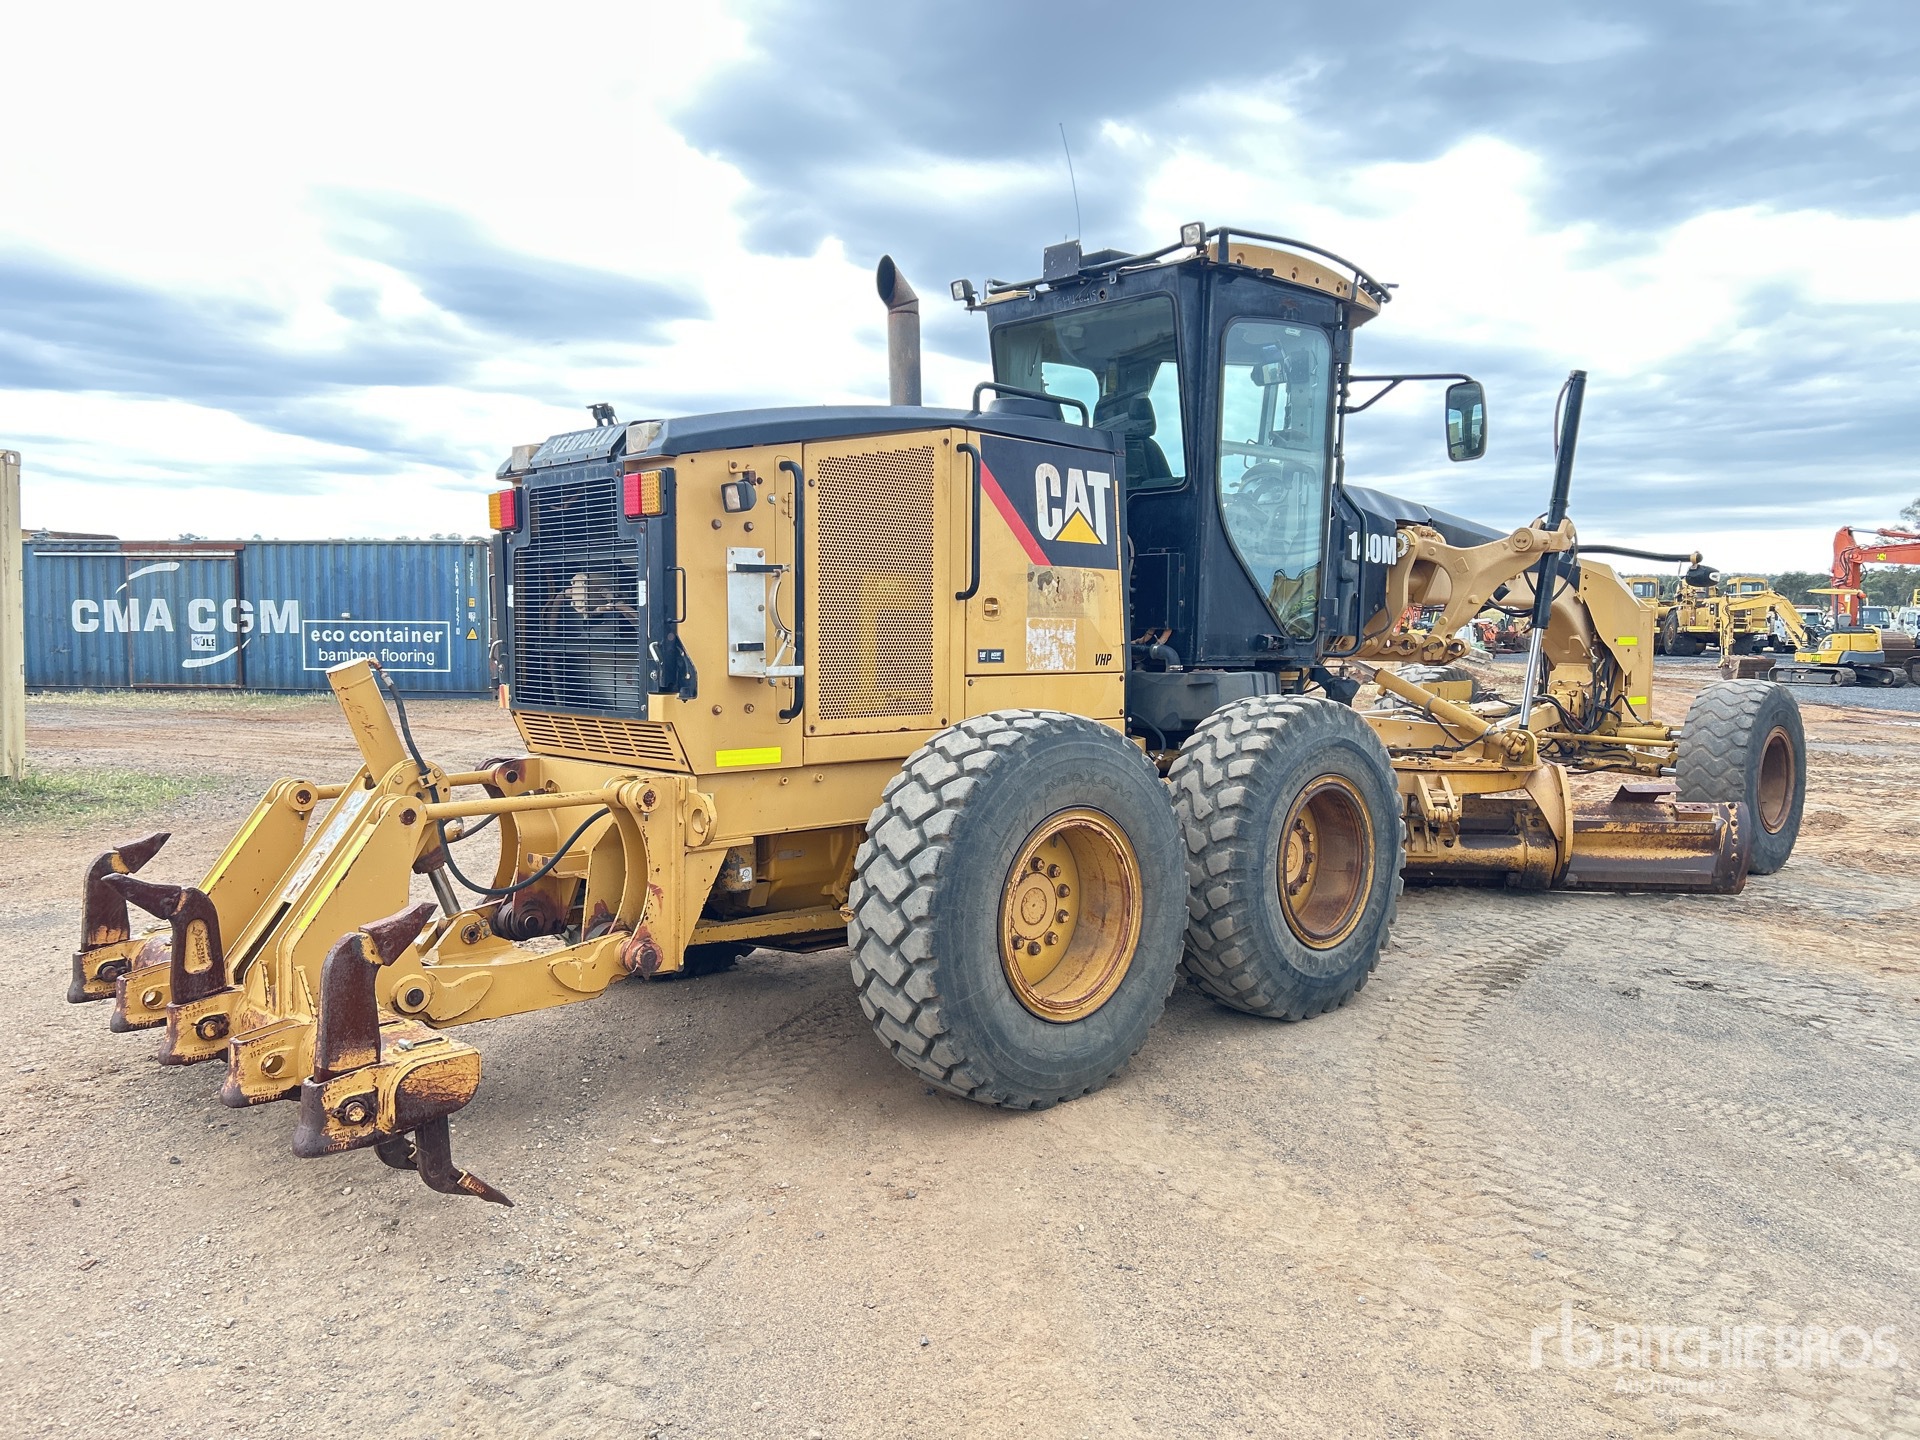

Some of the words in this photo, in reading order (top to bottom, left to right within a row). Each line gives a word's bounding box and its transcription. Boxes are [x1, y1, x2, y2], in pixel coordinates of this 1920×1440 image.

[1035, 462, 1111, 546] CAT
[71, 598, 174, 633] CMA
[188, 598, 300, 634] CGM
[311, 629, 345, 643] eco
[350, 627, 443, 643] container
[381, 648, 435, 666] flooring
[1095, 653, 1113, 666] VHP
